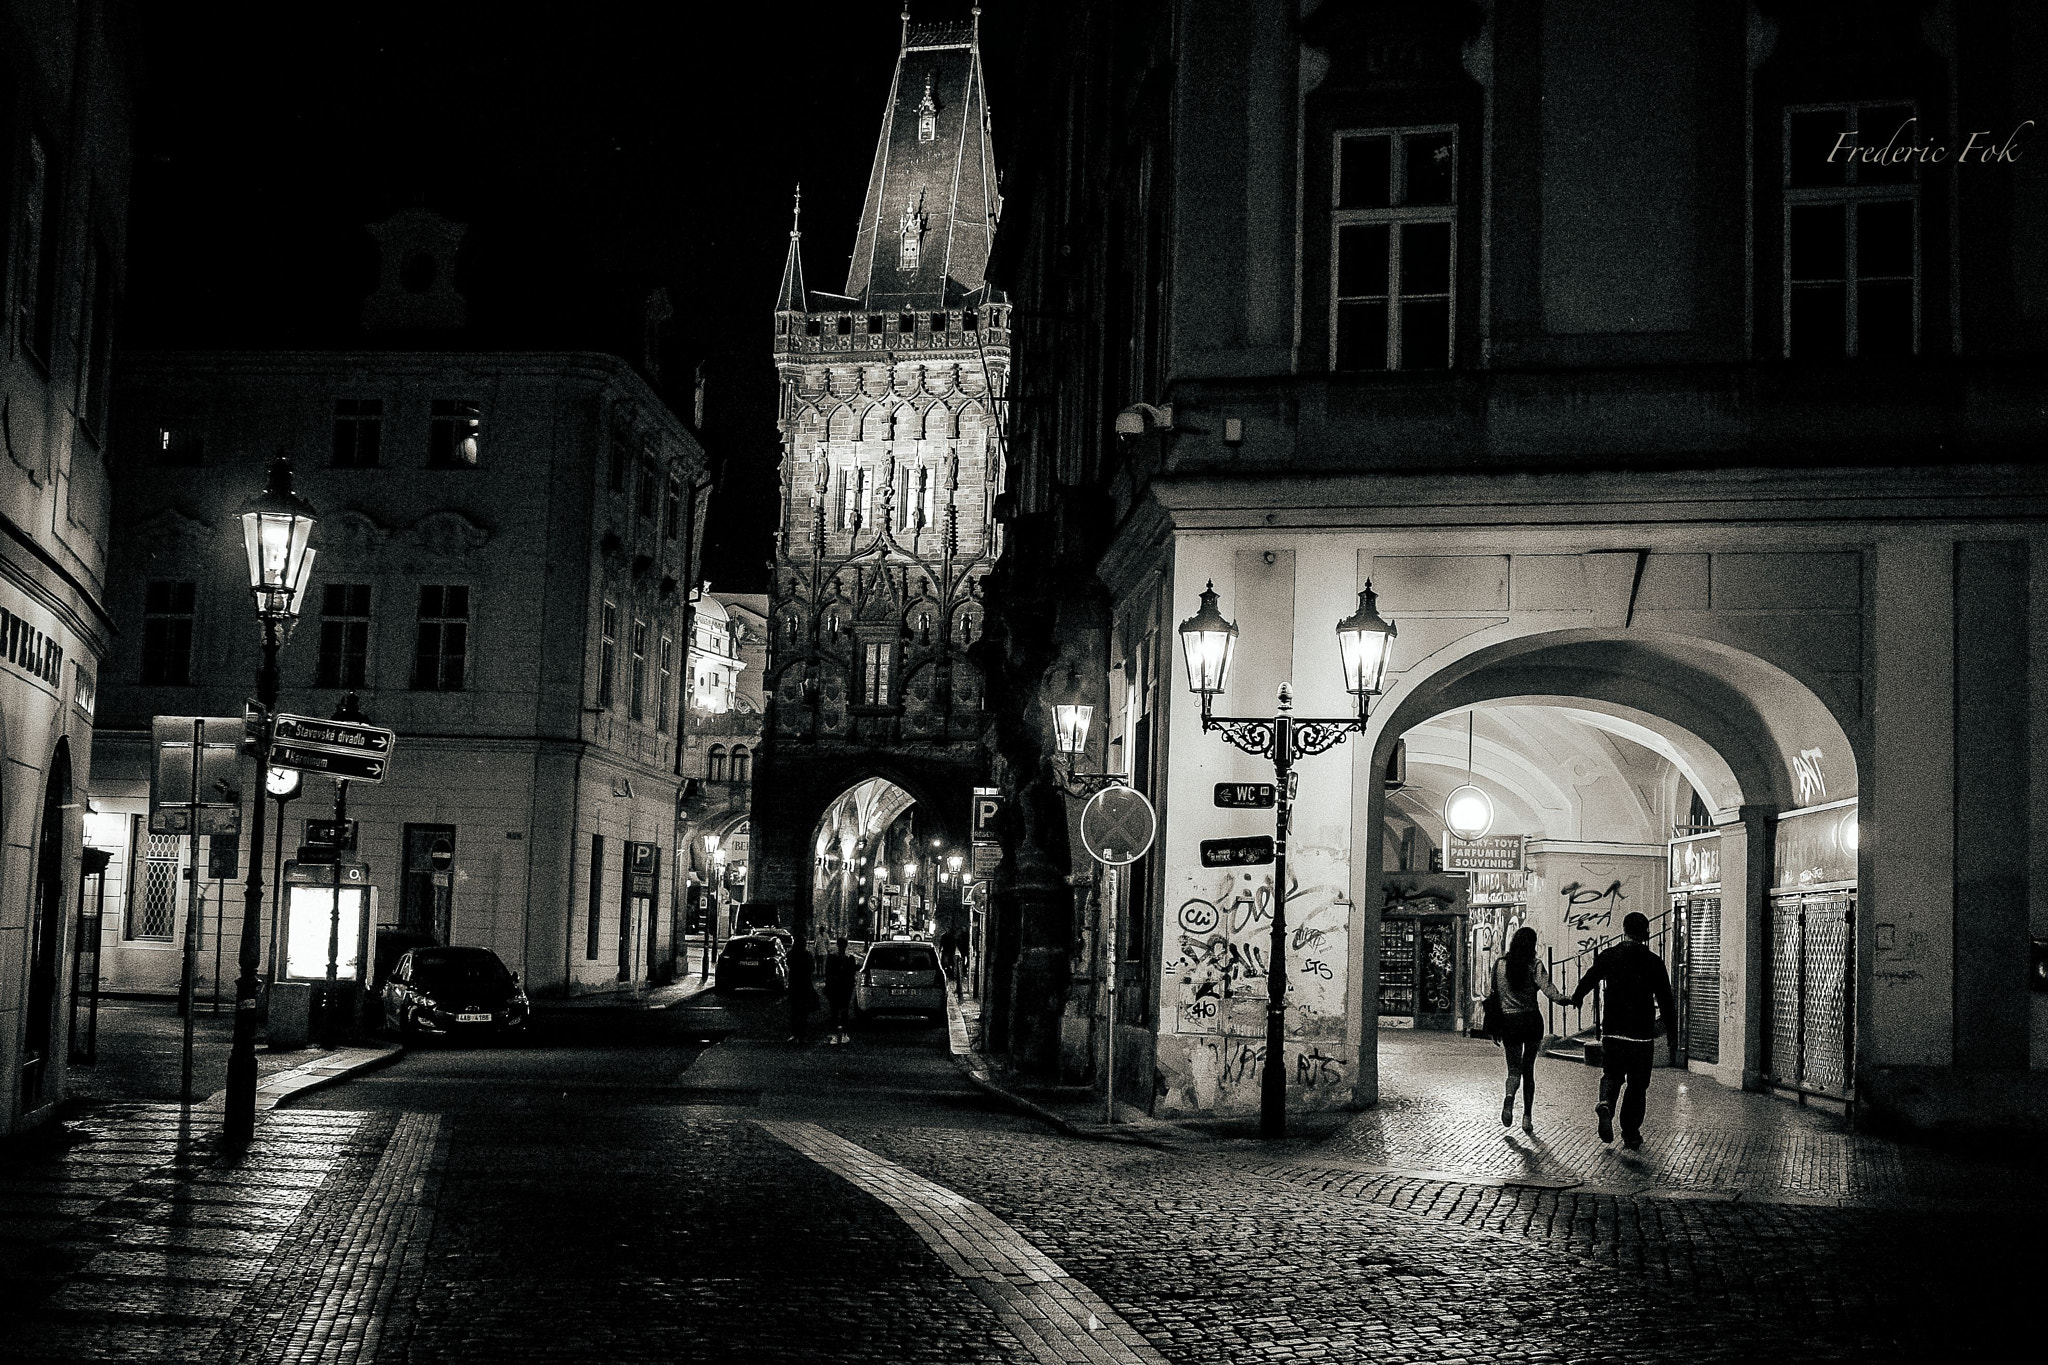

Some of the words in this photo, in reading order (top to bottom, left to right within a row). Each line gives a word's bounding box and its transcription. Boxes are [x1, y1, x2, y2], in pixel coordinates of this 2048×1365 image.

[295, 724, 335, 741] Stavovské
[338, 727, 366, 746] divadlo
[1236, 786, 1256, 801] WC
[979, 800, 999, 828] P
[636, 846, 650, 864] P
[1450, 848, 1517, 858] PARFUMERIE
[1455, 858, 1514, 869] SOUVENIRS
